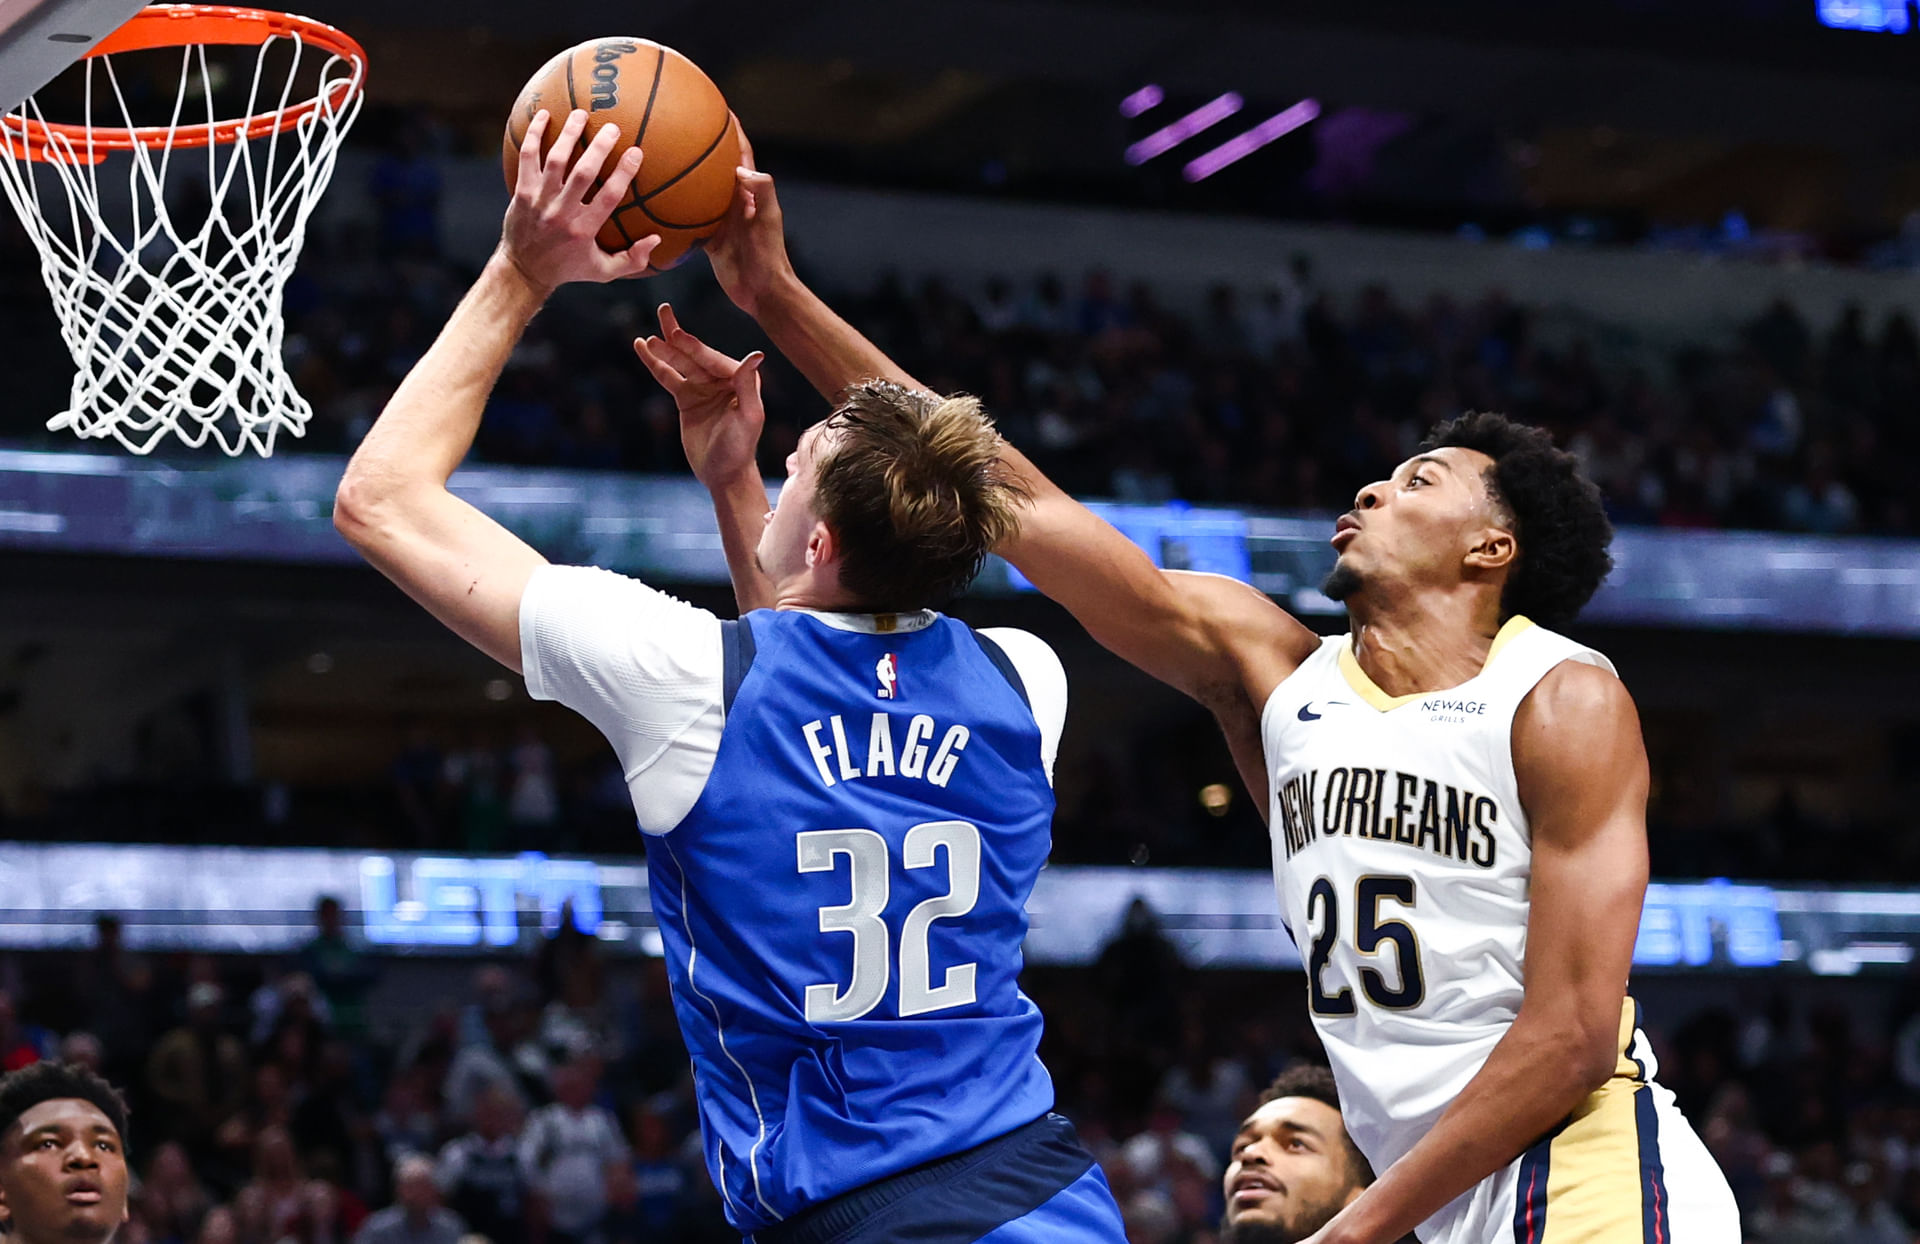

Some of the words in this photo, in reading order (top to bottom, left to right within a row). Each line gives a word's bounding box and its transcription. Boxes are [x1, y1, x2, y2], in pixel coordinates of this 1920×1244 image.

[591, 39, 638, 112] lson
[802, 712, 970, 789] FLAGG
[1420, 699, 1488, 715] NEWAGE
[1277, 768, 1319, 863] NEW
[1321, 766, 1499, 870] ORLEANS
[796, 820, 981, 1023] 32
[1307, 873, 1427, 1019] 25
